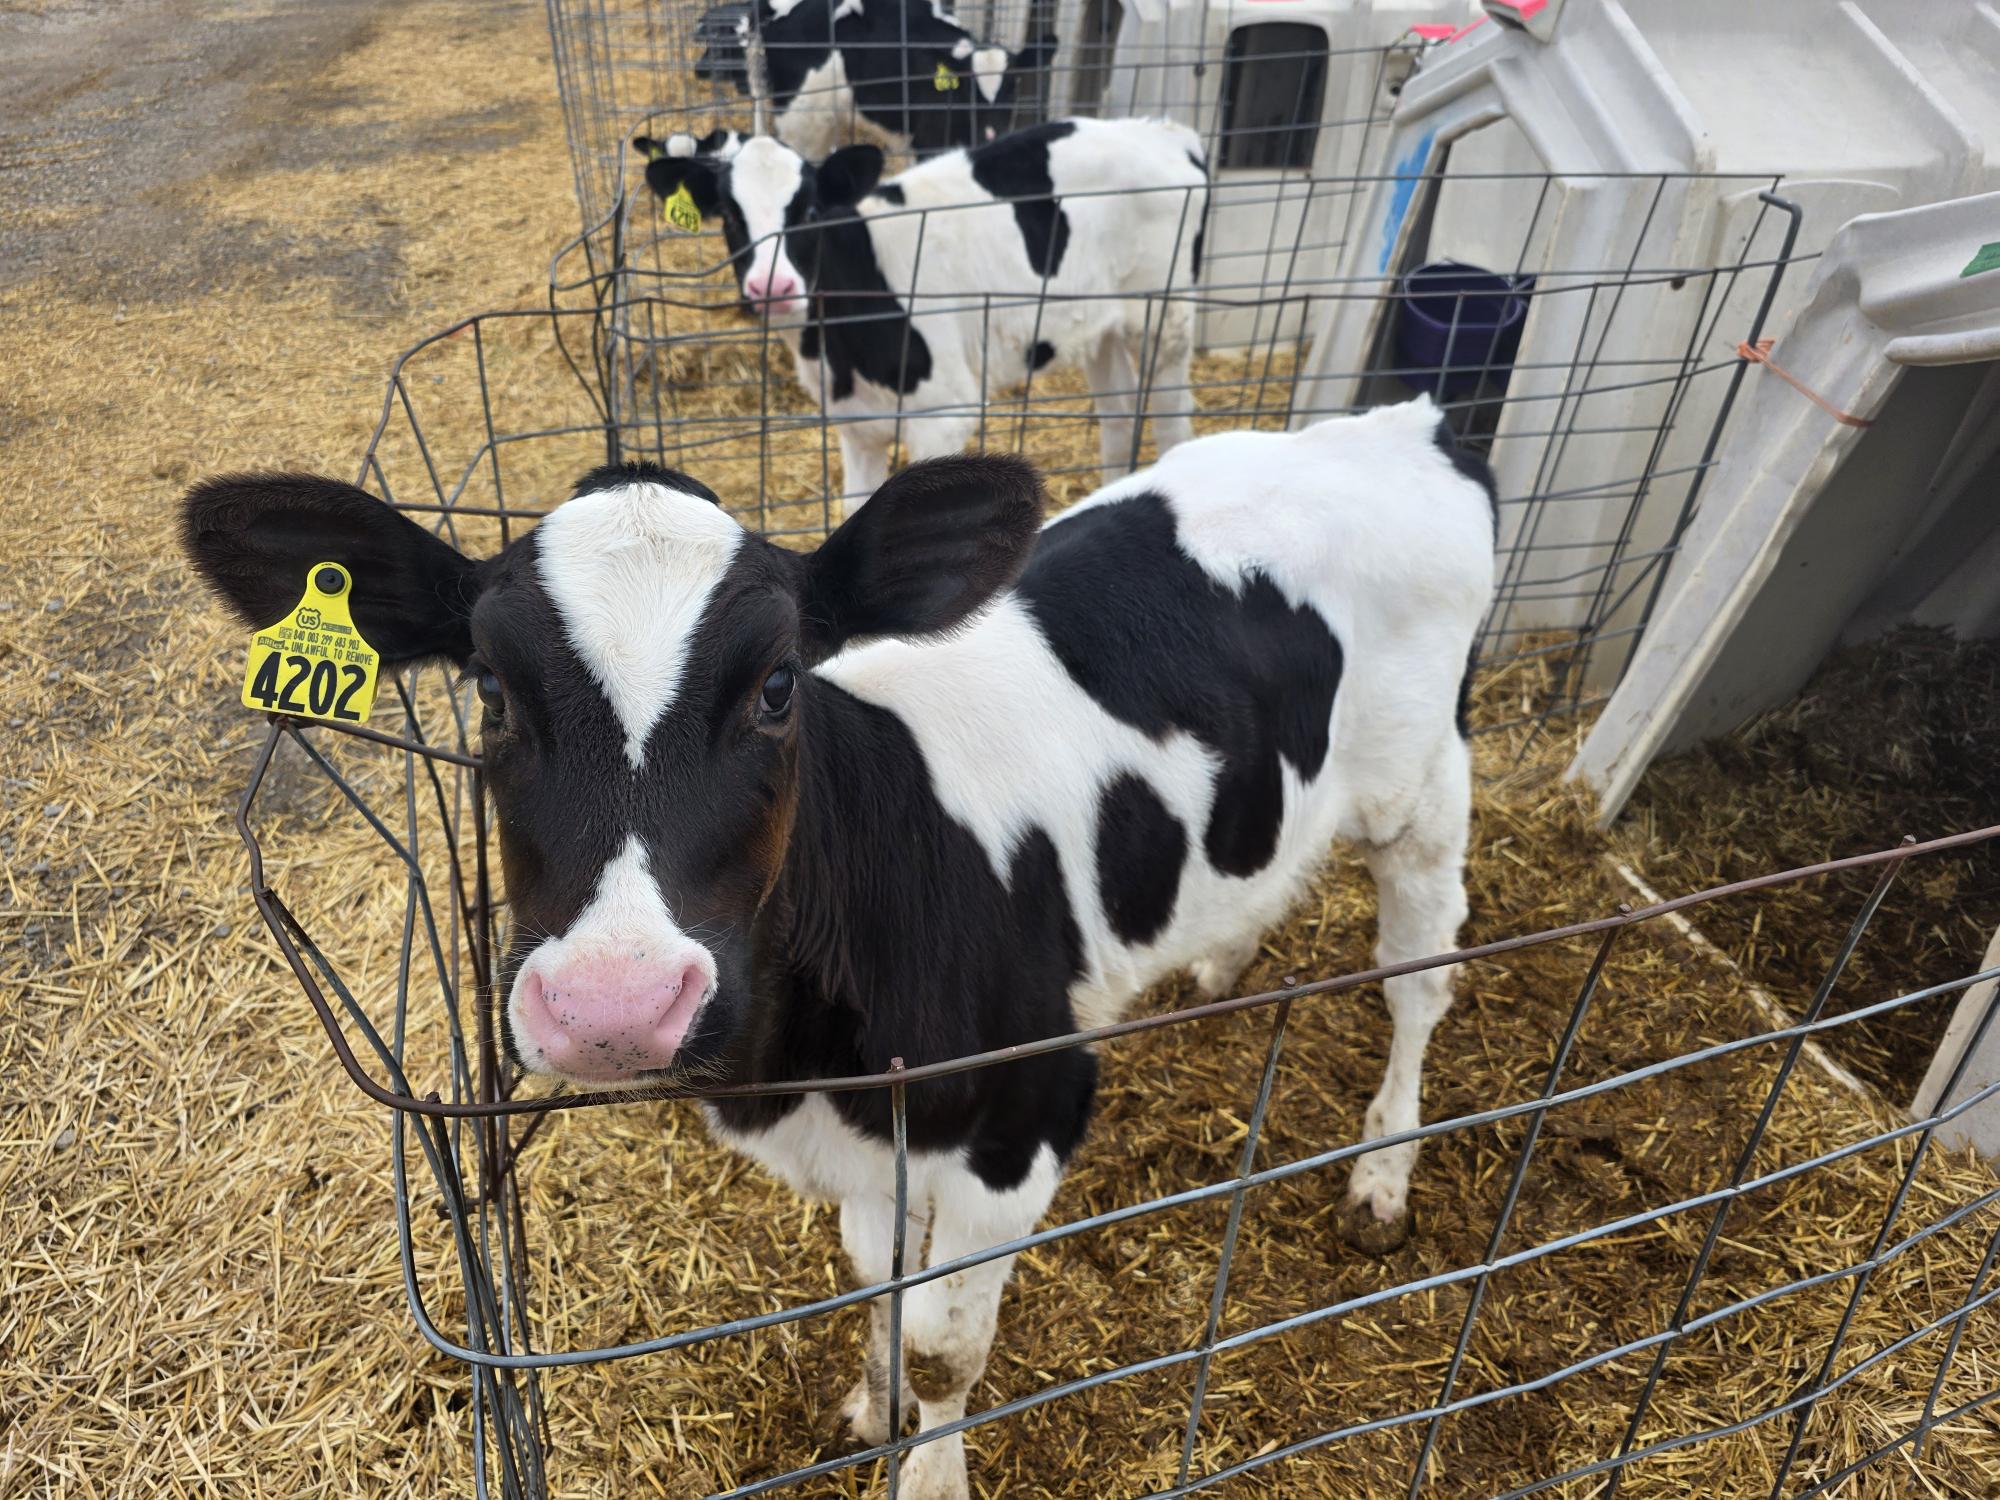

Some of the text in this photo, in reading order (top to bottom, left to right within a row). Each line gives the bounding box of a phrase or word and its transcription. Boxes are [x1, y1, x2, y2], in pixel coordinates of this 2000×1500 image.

[301, 614, 317, 625] US
[293, 629, 305, 641] 840
[308, 632, 319, 643] 003
[321, 634, 333, 645] 299
[291, 641, 374, 666] UNLAWFUL TO REMOVE
[250, 651, 367, 721] 4202
